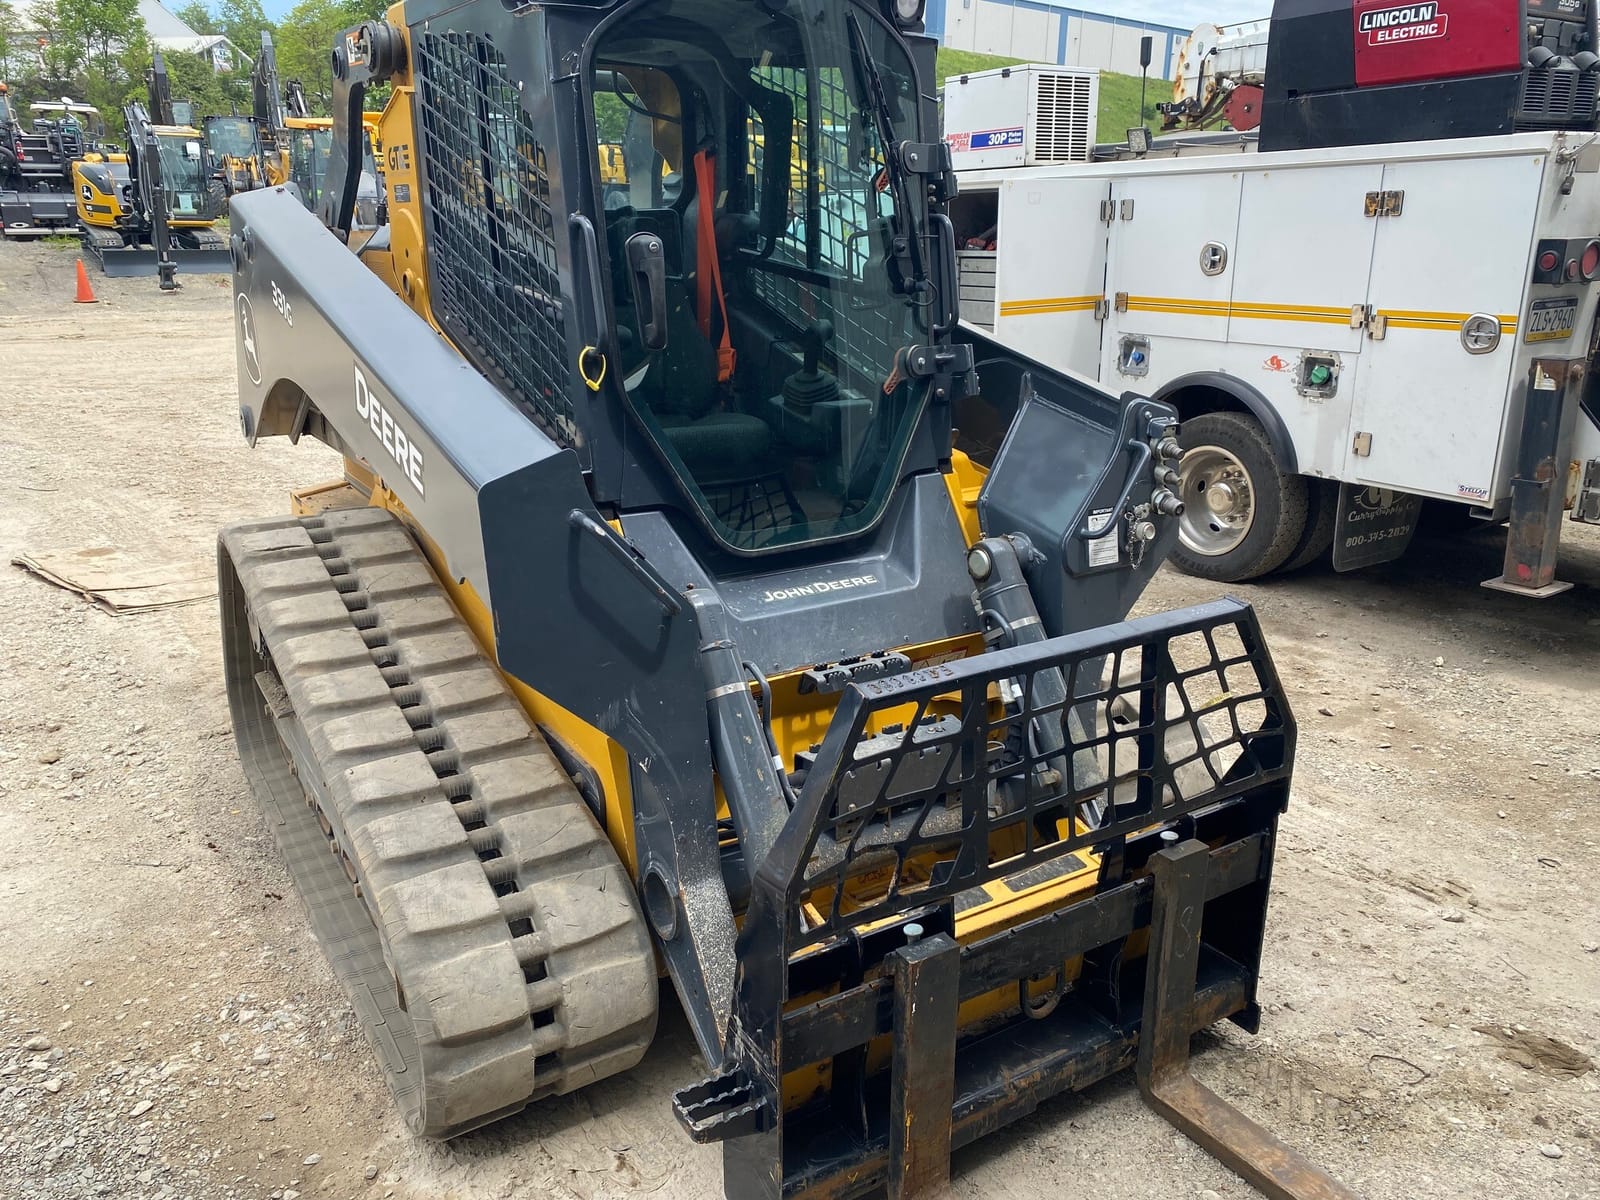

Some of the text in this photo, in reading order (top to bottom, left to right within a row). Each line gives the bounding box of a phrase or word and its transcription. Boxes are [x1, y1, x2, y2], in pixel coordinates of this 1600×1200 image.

[1363, 6, 1433, 29] LINCOLN
[1377, 23, 1438, 41] ELECTRIC
[988, 133, 1007, 145] 30P
[354, 365, 424, 496] DEERE
[764, 575, 878, 602] JOHN DEERE
